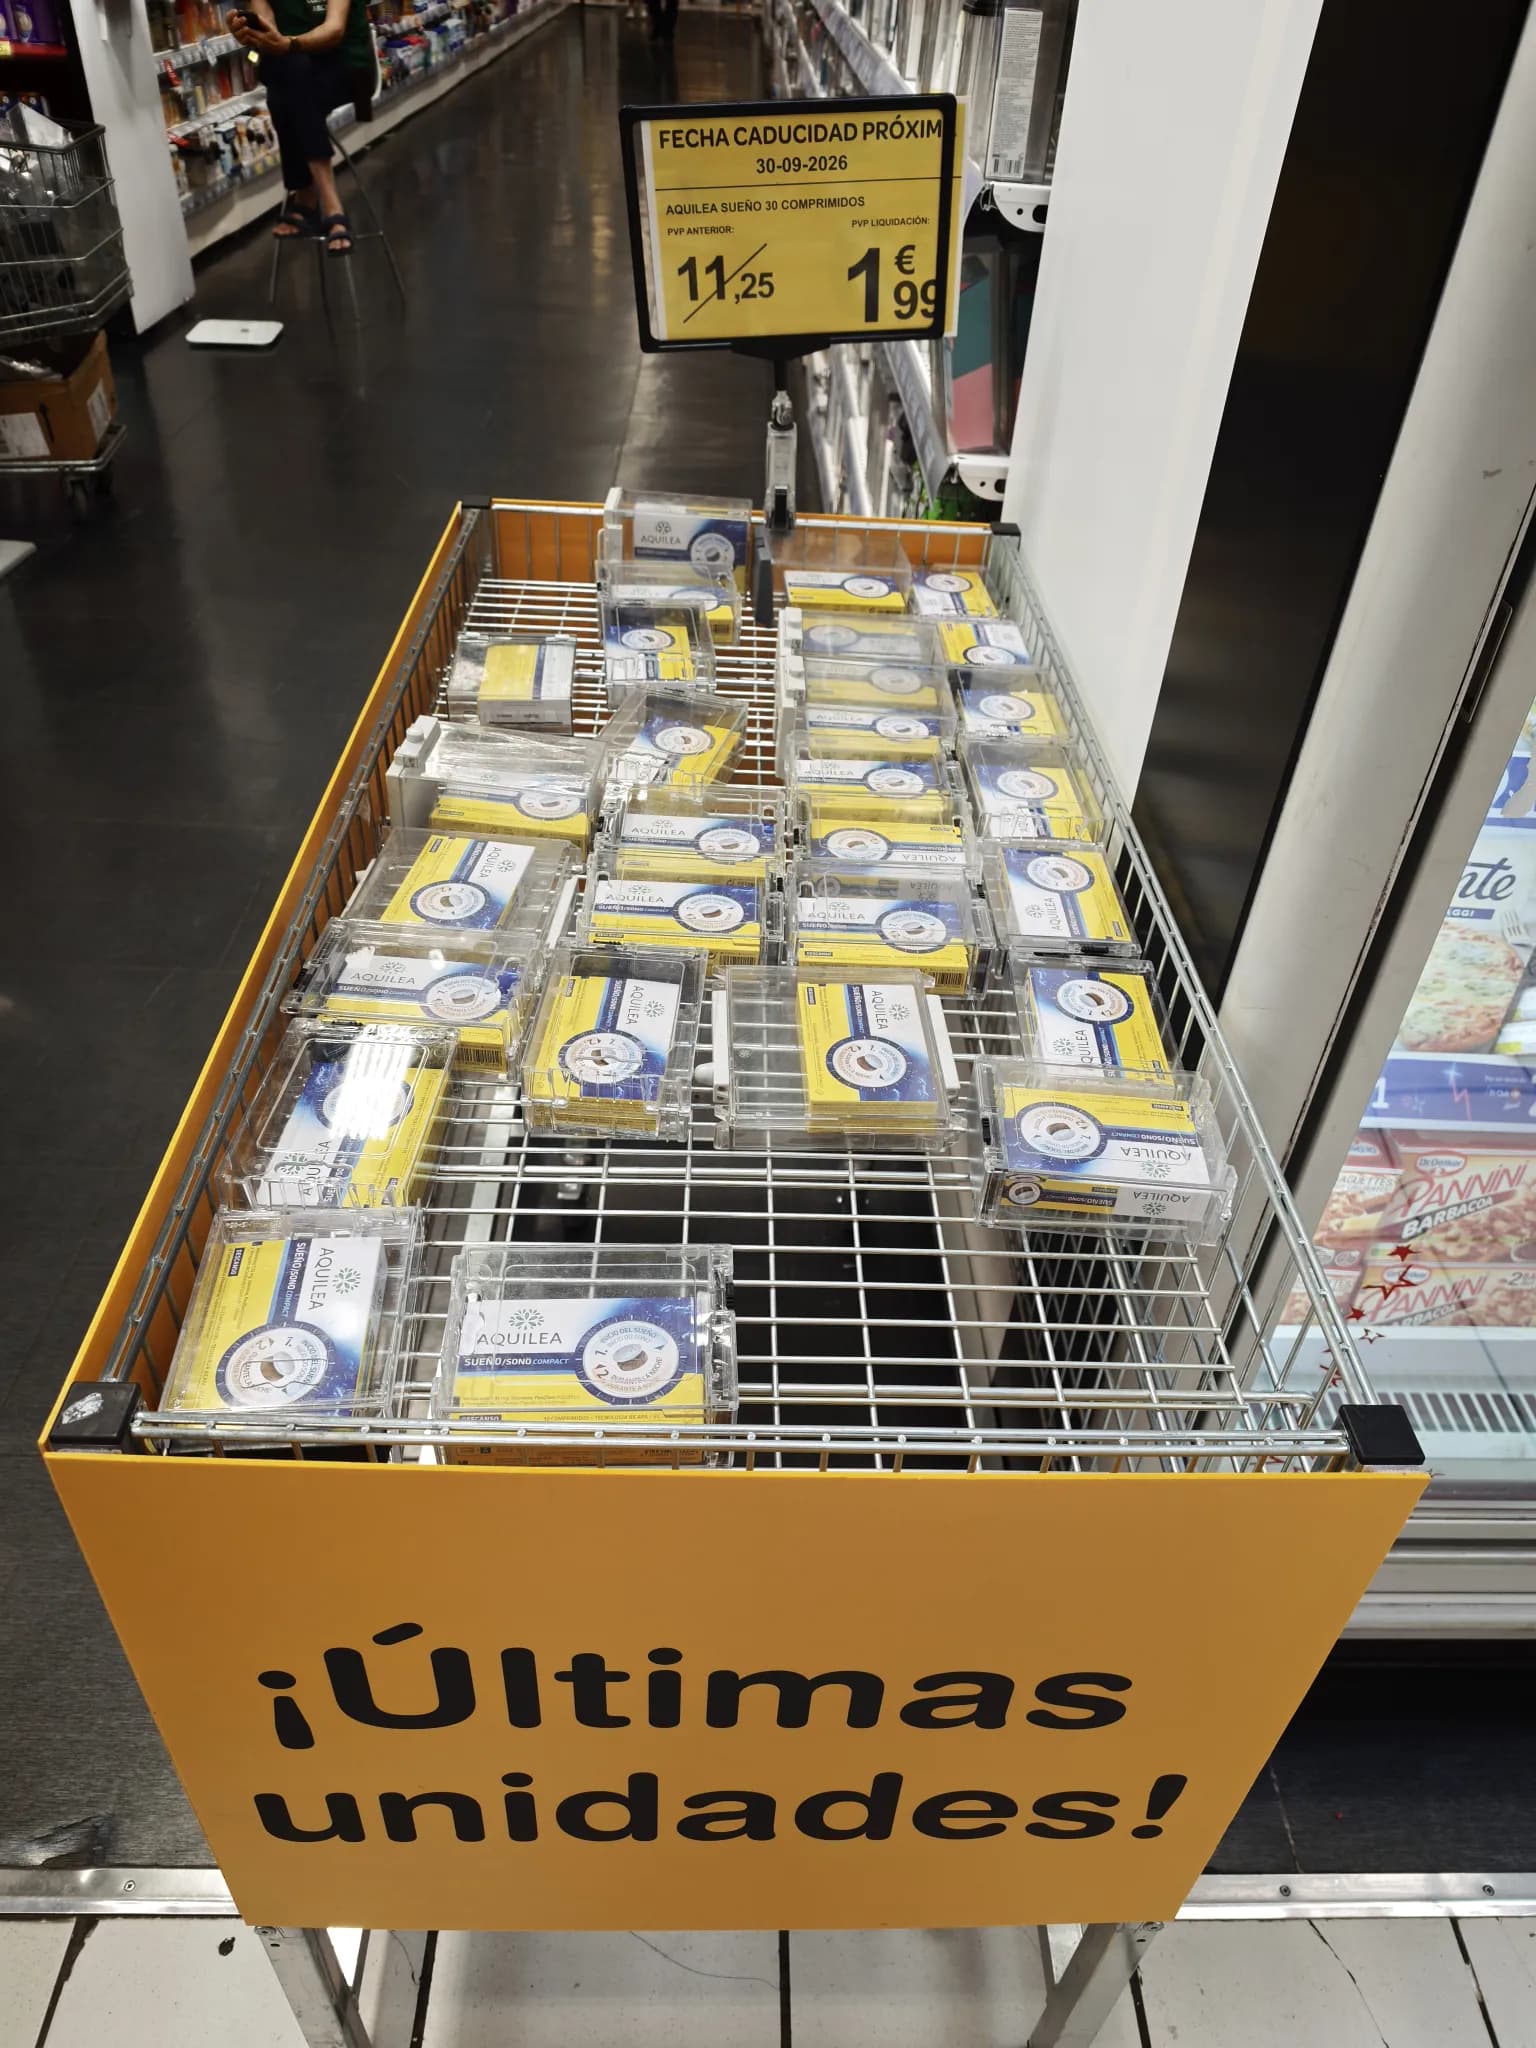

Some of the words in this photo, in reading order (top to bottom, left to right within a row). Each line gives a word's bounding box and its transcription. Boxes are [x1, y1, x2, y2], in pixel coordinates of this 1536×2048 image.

[659, 128, 729, 149] FECHA
[734, 121, 858, 146] CADUCIDAD
[862, 113, 942, 141] PRÓXIM
[756, 154, 848, 175] 30-09-2026
[666, 200, 718, 216] AQUILEA
[720, 198, 762, 213] SUEÑO
[765, 199, 778, 212] 30
[781, 196, 865, 210] COMPRIMIDOS
[667, 226, 685, 236] PVP
[686, 225, 735, 235] ANTERIOR:
[852, 218, 869, 228] PVP
[870, 215, 931, 227] LIQUIDACIÓN:
[847, 247, 881, 323] 1
[894, 244, 916, 275] €
[640, 534, 681, 545] AQUILEA
[807, 911, 866, 920] AQUILEA
[1447, 908, 1475, 917] GGI
[350, 972, 416, 985] AQUILEA
[626, 985, 645, 1025] AQUILEA
[871, 990, 889, 1030] AQUILEA
[1075, 1029, 1094, 1064] QUILEA
[1120, 1146, 1192, 1161] AQUILEA
[1133, 1191, 1191, 1203] AQUILEA
[1391, 1159, 1529, 1217] PANNINI
[1401, 1196, 1494, 1240] BARBACOA
[309, 1247, 335, 1310] AQUILEA
[477, 1332, 562, 1347] AQUILEA
[257, 1622, 1133, 1750] ¡Últimas
[253, 1772, 1188, 1843] unidades!
